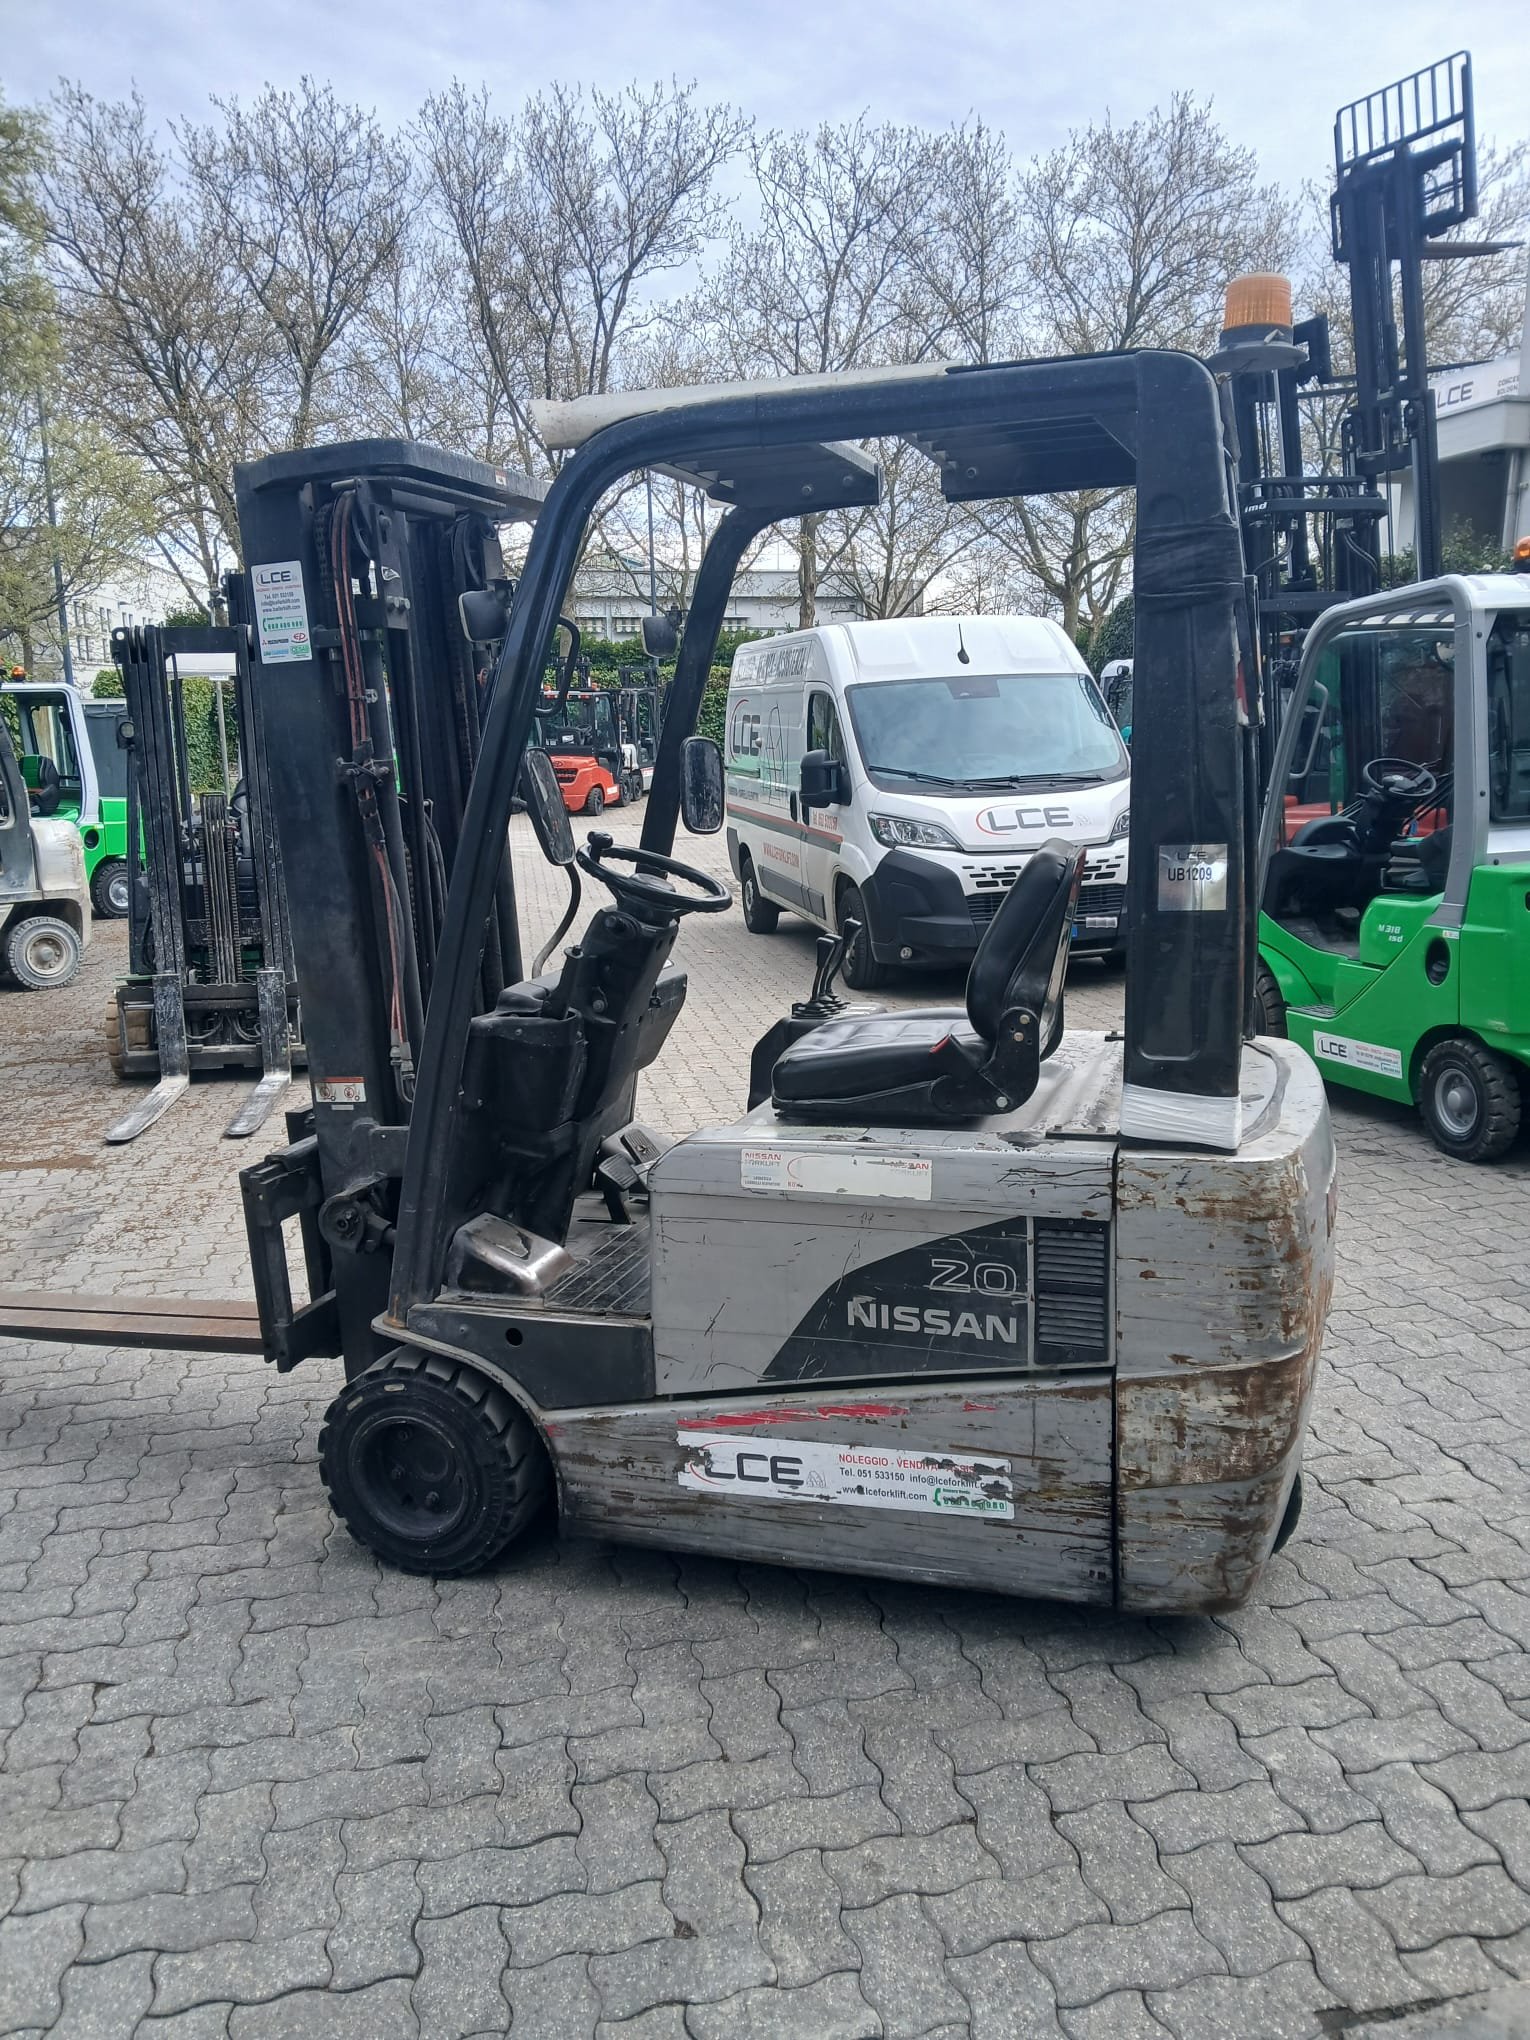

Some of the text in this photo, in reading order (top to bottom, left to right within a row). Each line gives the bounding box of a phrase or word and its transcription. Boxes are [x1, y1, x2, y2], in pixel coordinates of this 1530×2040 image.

[1437, 380, 1474, 409] LCE
[260, 570, 291, 585] LCE
[733, 714, 761, 757] LCE
[987, 806, 1074, 832] LCE
[1168, 867, 1212, 881] UB1209
[1320, 1039, 1348, 1058] LCE
[744, 1152, 782, 1161] NISSAN
[929, 1258, 1017, 1298] 20
[847, 1299, 1017, 1344] NISSAN
[704, 1452, 804, 1486] LCE
[839, 1454, 889, 1467] NOLEGGIO
[840, 1467, 856, 1477] Tel.
[857, 1469, 872, 1478] 051
[874, 1471, 905, 1482] 533150
